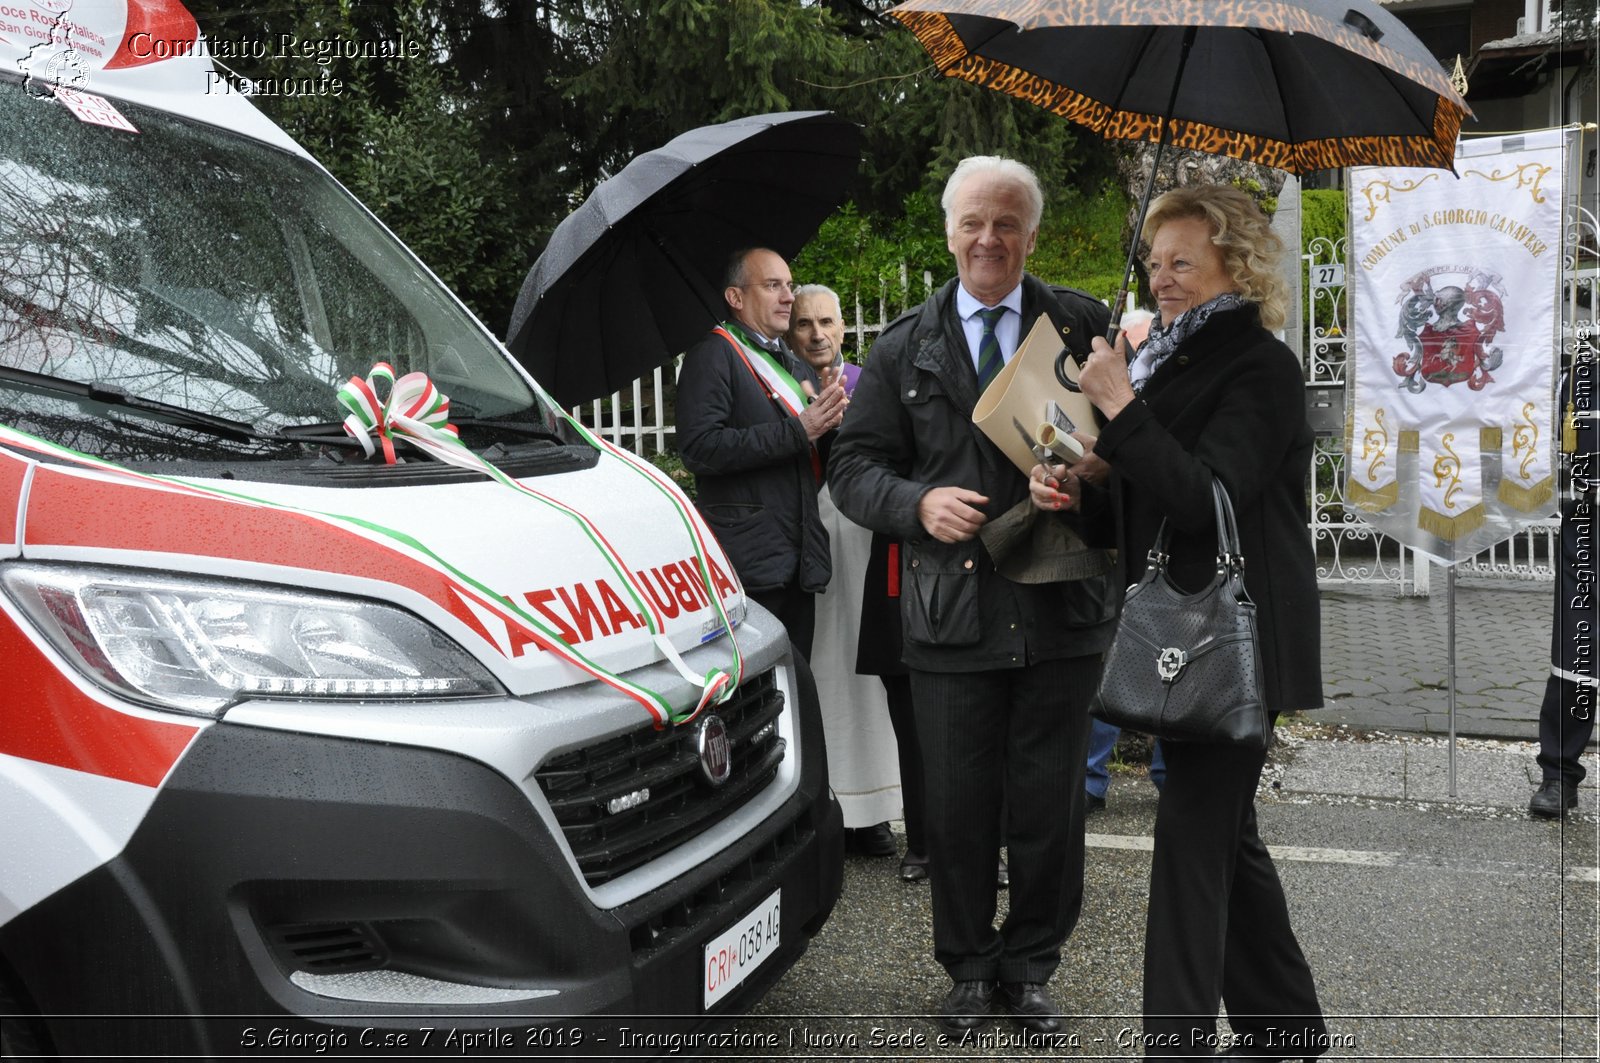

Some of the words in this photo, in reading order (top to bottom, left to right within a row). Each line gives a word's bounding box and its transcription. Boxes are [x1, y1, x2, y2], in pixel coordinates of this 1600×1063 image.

[24, 25, 62, 43] Gioro
[1362, 227, 1407, 270] COMUNE
[1423, 208, 1488, 229] S.GIORGIO
[1489, 213, 1548, 258] CANAVESE
[1319, 268, 1335, 283] 27
[708, 944, 732, 992] CRI
[738, 920, 763, 967] 038
[766, 904, 780, 945] AG
